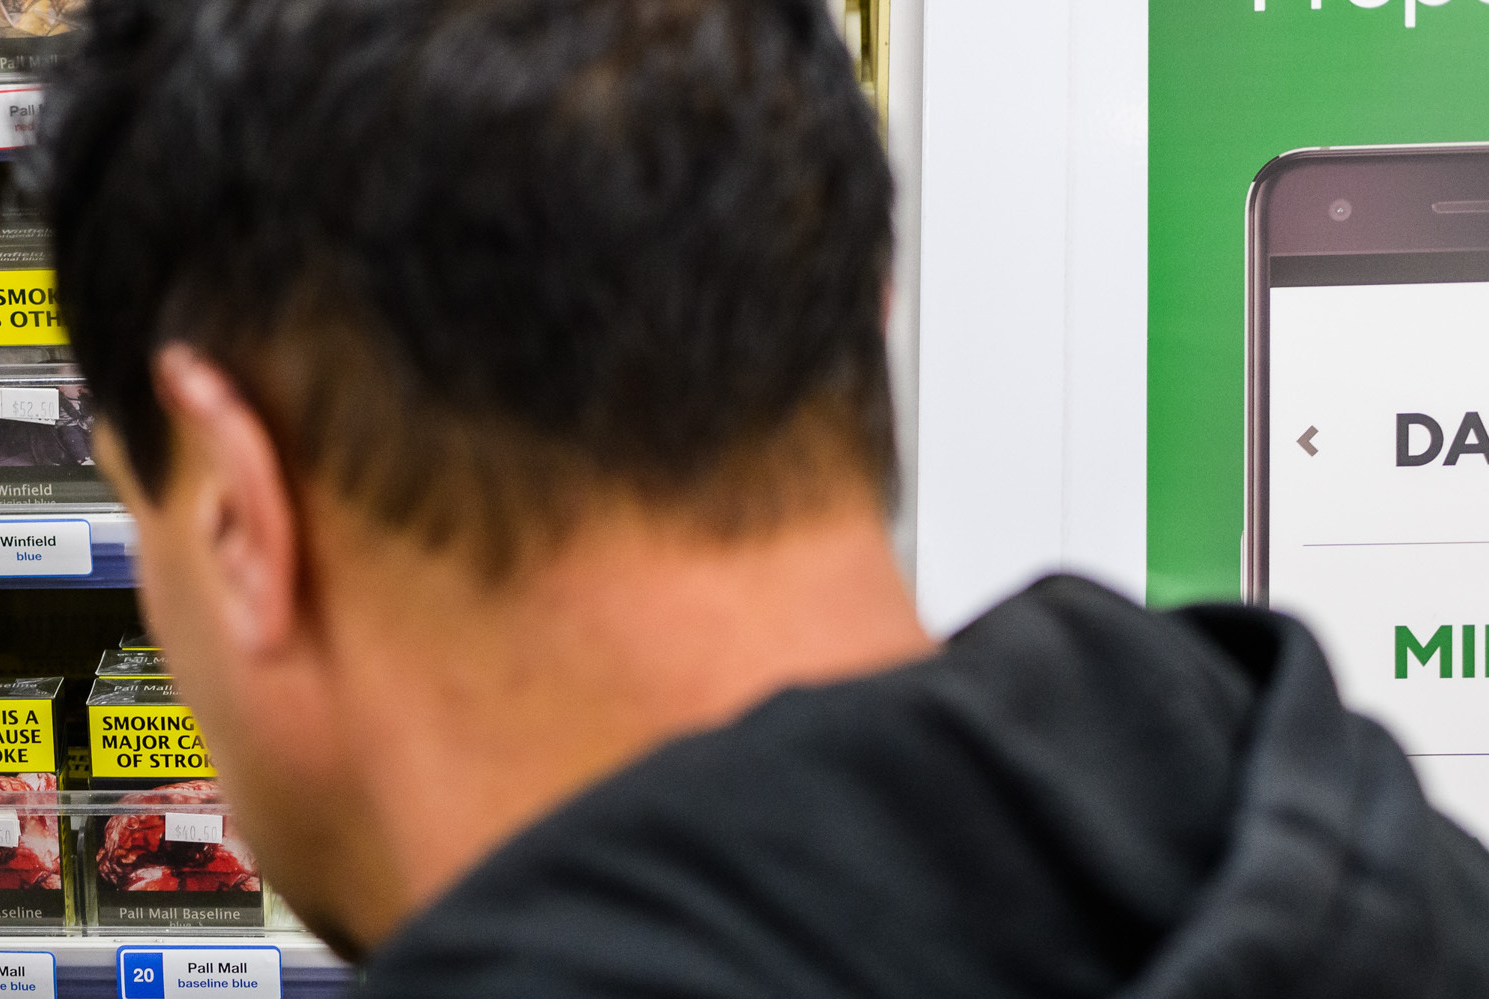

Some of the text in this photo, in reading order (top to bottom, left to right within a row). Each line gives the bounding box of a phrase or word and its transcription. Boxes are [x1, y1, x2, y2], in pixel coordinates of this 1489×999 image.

[13, 401, 54, 417] $52.50
[0, 536, 56, 547] Winfield
[16, 551, 42, 562] blue
[1394, 624, 1489, 679] MI
[2, 710, 19, 725] IS
[25, 711, 39, 724] A
[102, 716, 195, 731] SMOKING
[102, 735, 169, 752] MAJOR
[117, 754, 143, 768] OF
[120, 908, 240, 920] Pall Mall Baseline
[187, 962, 247, 974] Pall Mall
[133, 968, 154, 983] 20
[11, 981, 36, 991] blue
[178, 978, 258, 989] baseline blue
